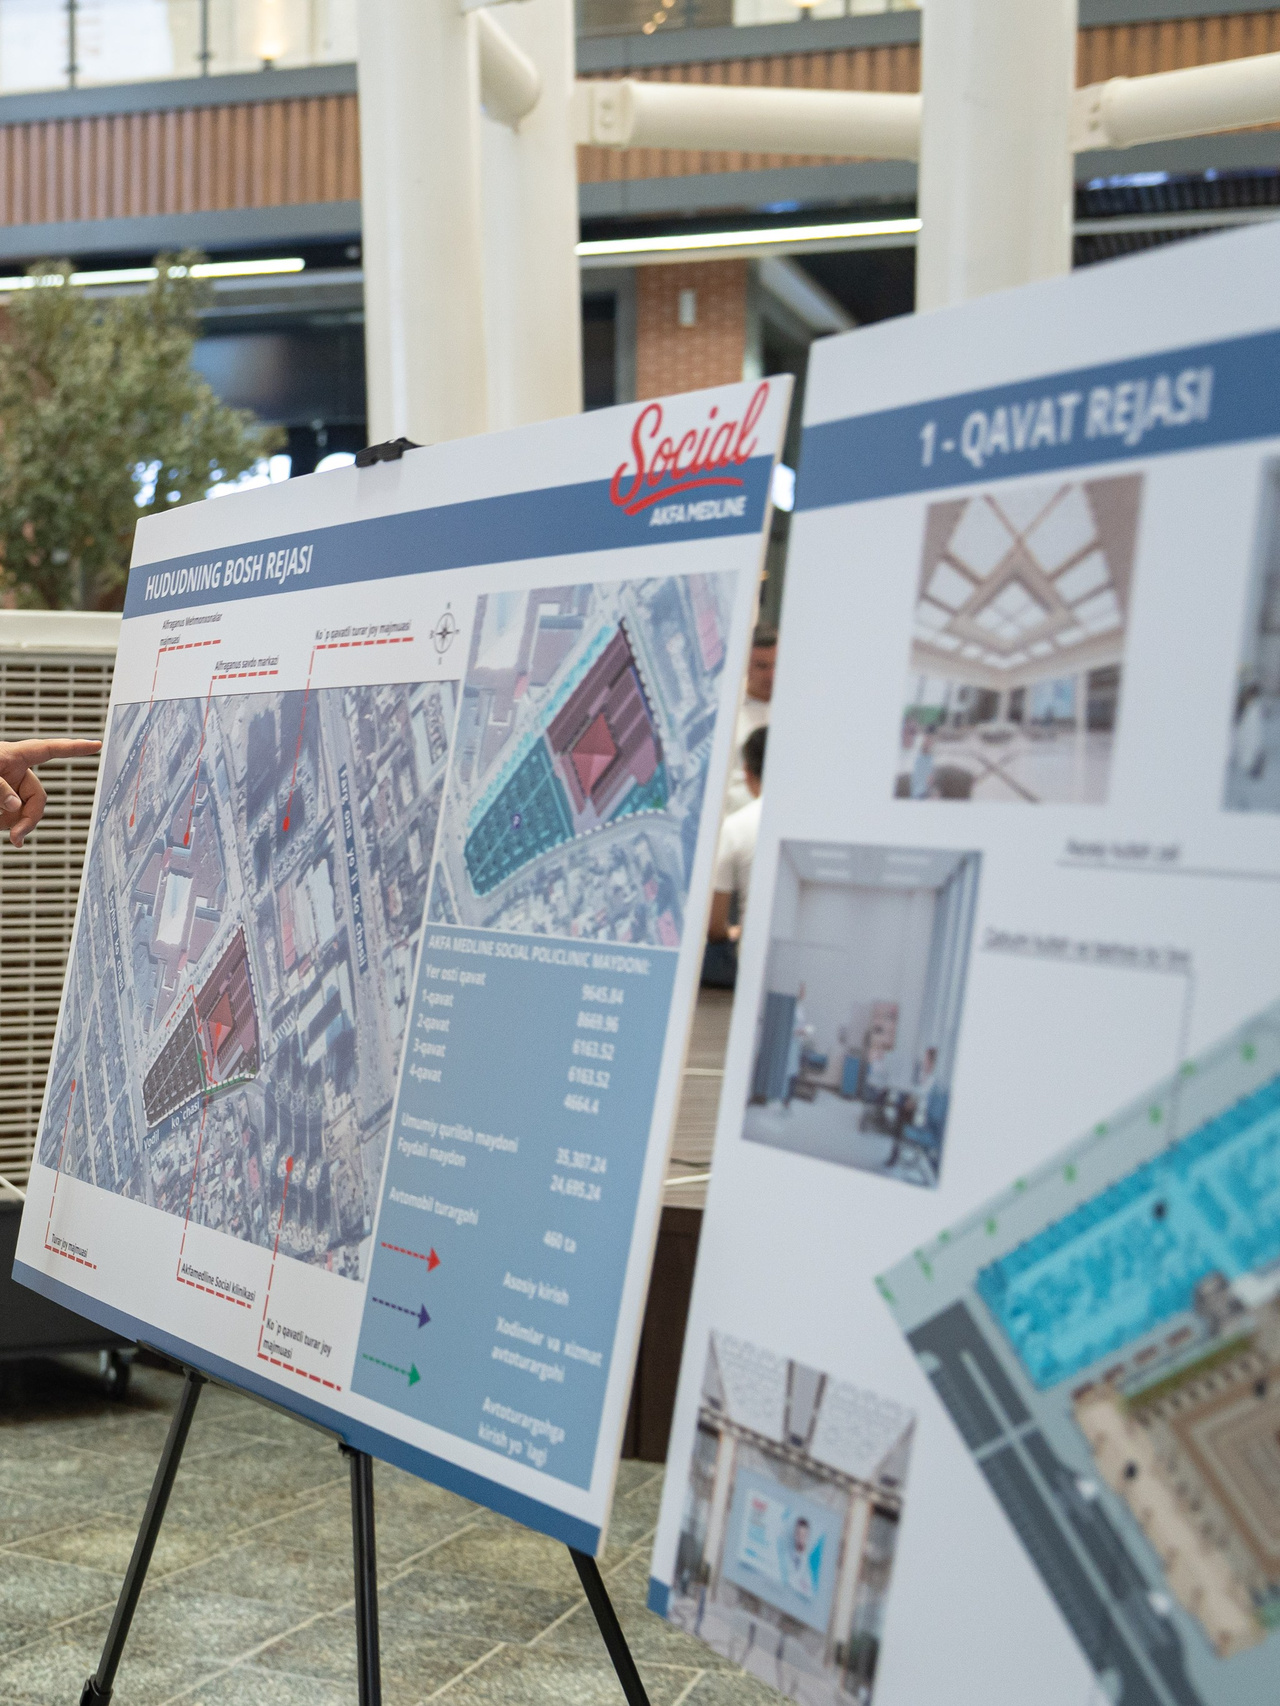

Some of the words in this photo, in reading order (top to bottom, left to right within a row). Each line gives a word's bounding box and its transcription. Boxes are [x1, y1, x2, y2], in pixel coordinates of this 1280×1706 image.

[1084, 366, 1215, 447] REJASI
[608, 381, 770, 507] Social
[649, 503, 687, 527] AKFA
[687, 495, 747, 523] MEDLINE
[144, 561, 222, 601] HUDUDNING
[223, 554, 264, 587] BOSH
[265, 544, 314, 585] REJASI
[379, 620, 412, 636] majmuasi
[214, 660, 241, 673] Alfraganus
[241, 657, 257, 668] savdo
[257, 655, 279, 667] markazi
[428, 935, 452, 950] AKFA
[452, 937, 495, 957] MEDLINE
[495, 941, 528, 962] SOCIAL
[426, 964, 440, 979] Yer
[440, 966, 458, 982] osti
[459, 970, 486, 987] qavat
[389, 1186, 434, 1212] Avtomobil
[181, 1263, 214, 1285] Akfamedline
[215, 1276, 232, 1292] Social
[231, 1284, 256, 1302] klinikasi
[263, 1338, 294, 1360] majmuasi
[282, 1327, 304, 1344] qavatli
[304, 1333, 321, 1350] turar
[320, 1341, 333, 1358] joy
